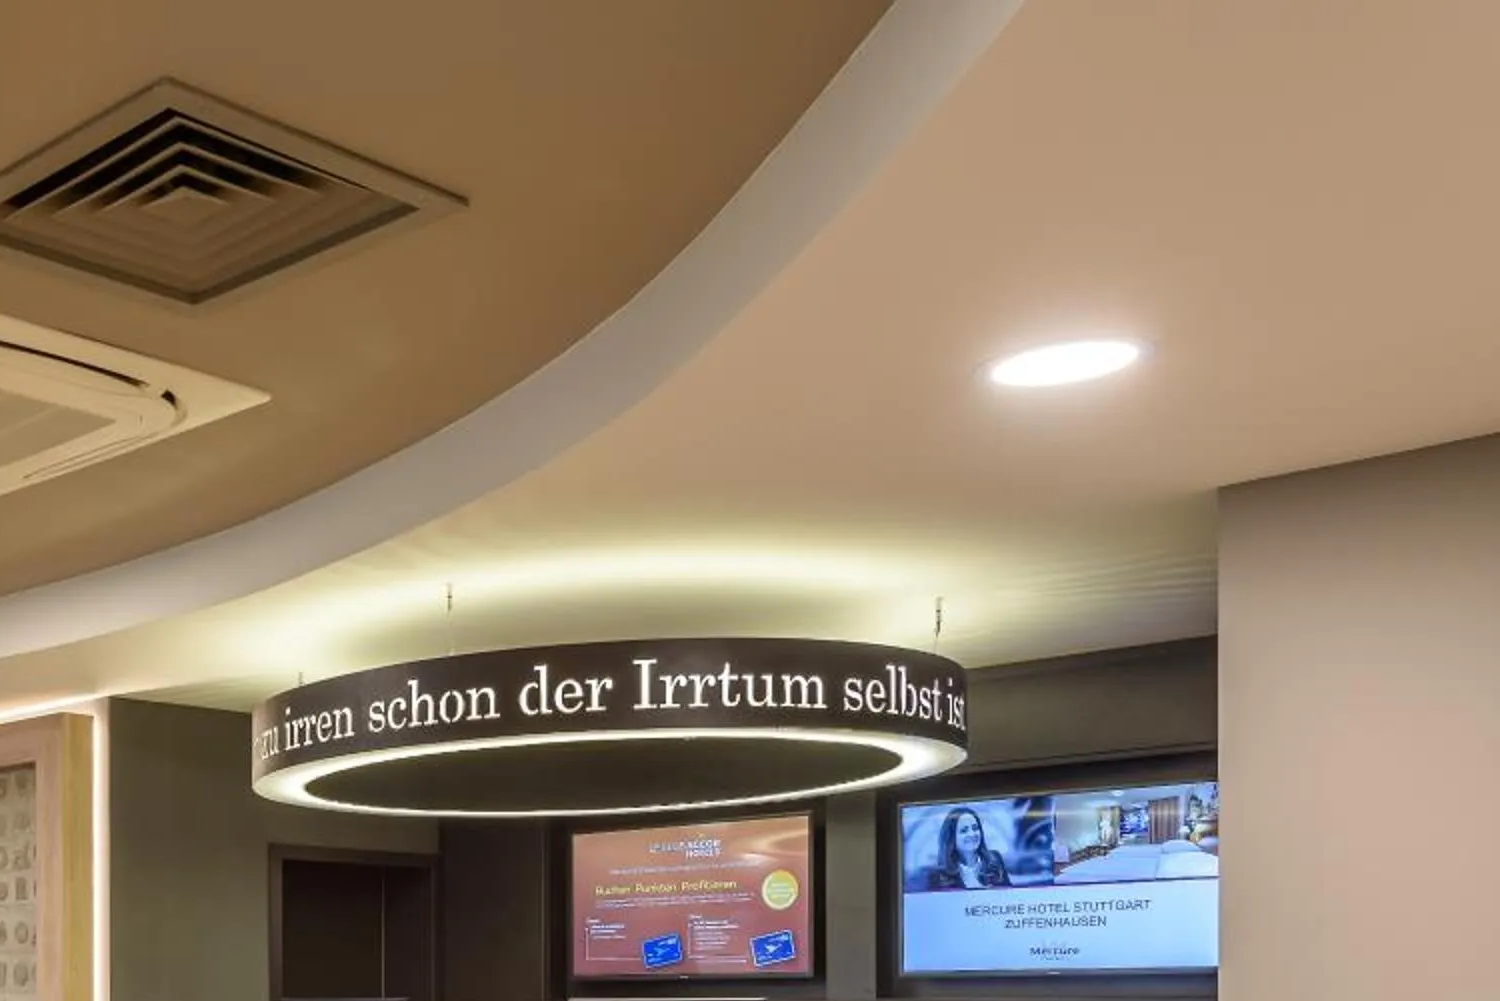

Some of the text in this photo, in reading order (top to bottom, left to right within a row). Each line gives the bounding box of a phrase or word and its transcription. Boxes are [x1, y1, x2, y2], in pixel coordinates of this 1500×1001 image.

[284, 705, 356, 752] irren
[367, 678, 501, 733] schon
[518, 663, 614, 716] der
[632, 657, 829, 711] Irrtum
[843, 663, 944, 722] selbst
[1028, 901, 1070, 915] HOTEL
[1073, 898, 1152, 913] STUTTGART
